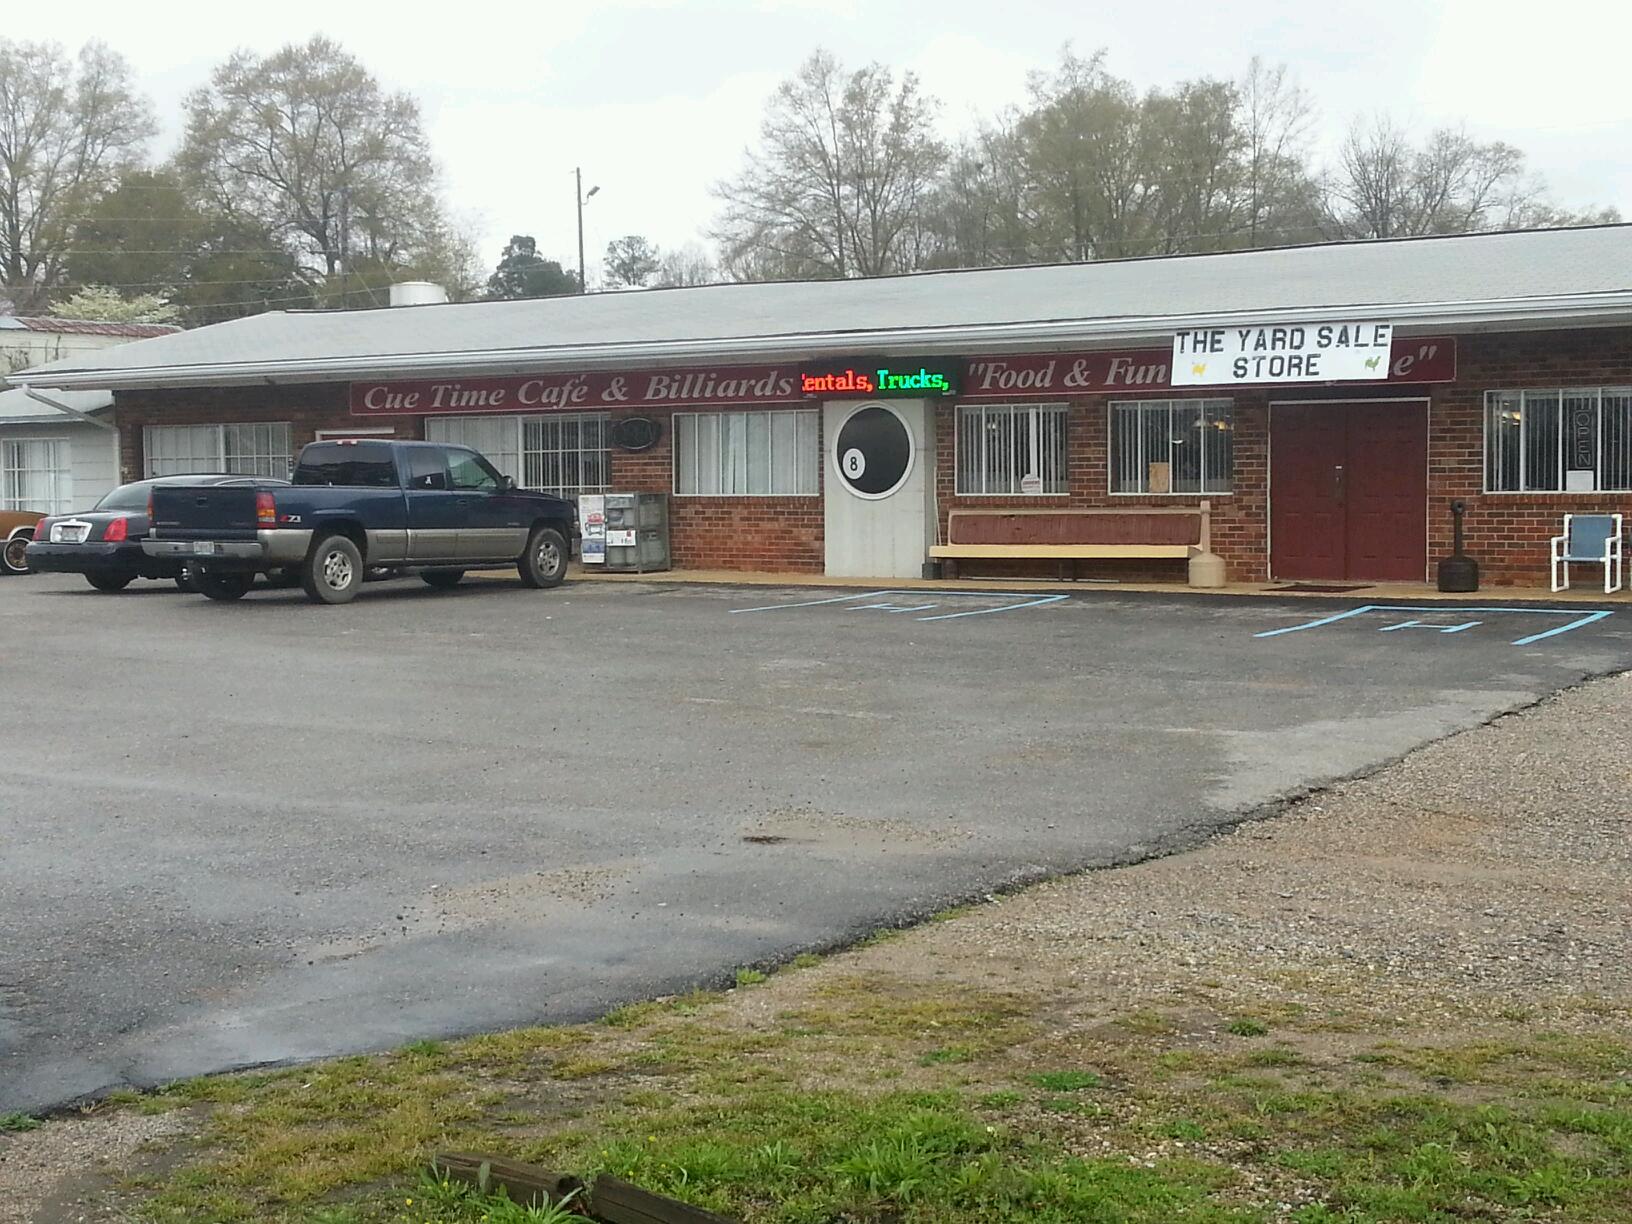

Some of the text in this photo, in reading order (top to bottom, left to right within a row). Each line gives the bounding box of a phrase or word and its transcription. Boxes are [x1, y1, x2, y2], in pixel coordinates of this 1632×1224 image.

[1176, 324, 1390, 354] THE YARD SALE
[877, 368, 949, 391] Trucks,
[968, 357, 1167, 390] "Food & Fun
[1232, 353, 1321, 379] STORE
[364, 371, 794, 409] Cue Time Café & Billiards
[850, 456, 858, 471] 8
